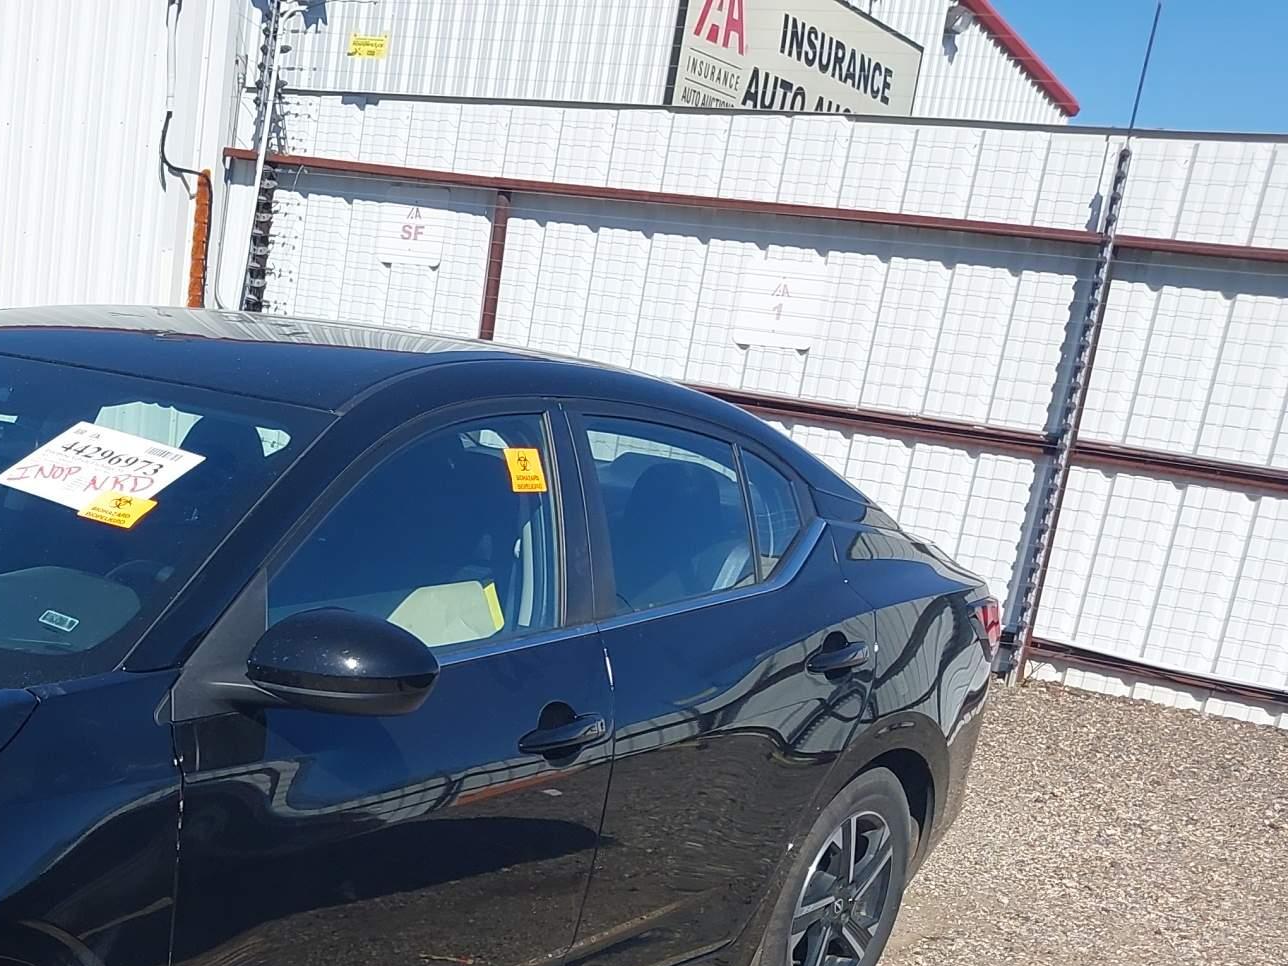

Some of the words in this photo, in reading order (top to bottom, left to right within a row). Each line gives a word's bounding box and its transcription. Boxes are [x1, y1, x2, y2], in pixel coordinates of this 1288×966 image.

[686, 55, 741, 92] INSURANCE
[779, 13, 894, 106] INSURANCE
[681, 86, 701, 107] AUTO
[741, 67, 806, 111] AUTO
[400, 224, 425, 241] SF
[772, 303, 783, 320] 1
[61, 441, 164, 476] 44296973
[6, 464, 82, 482] INOP
